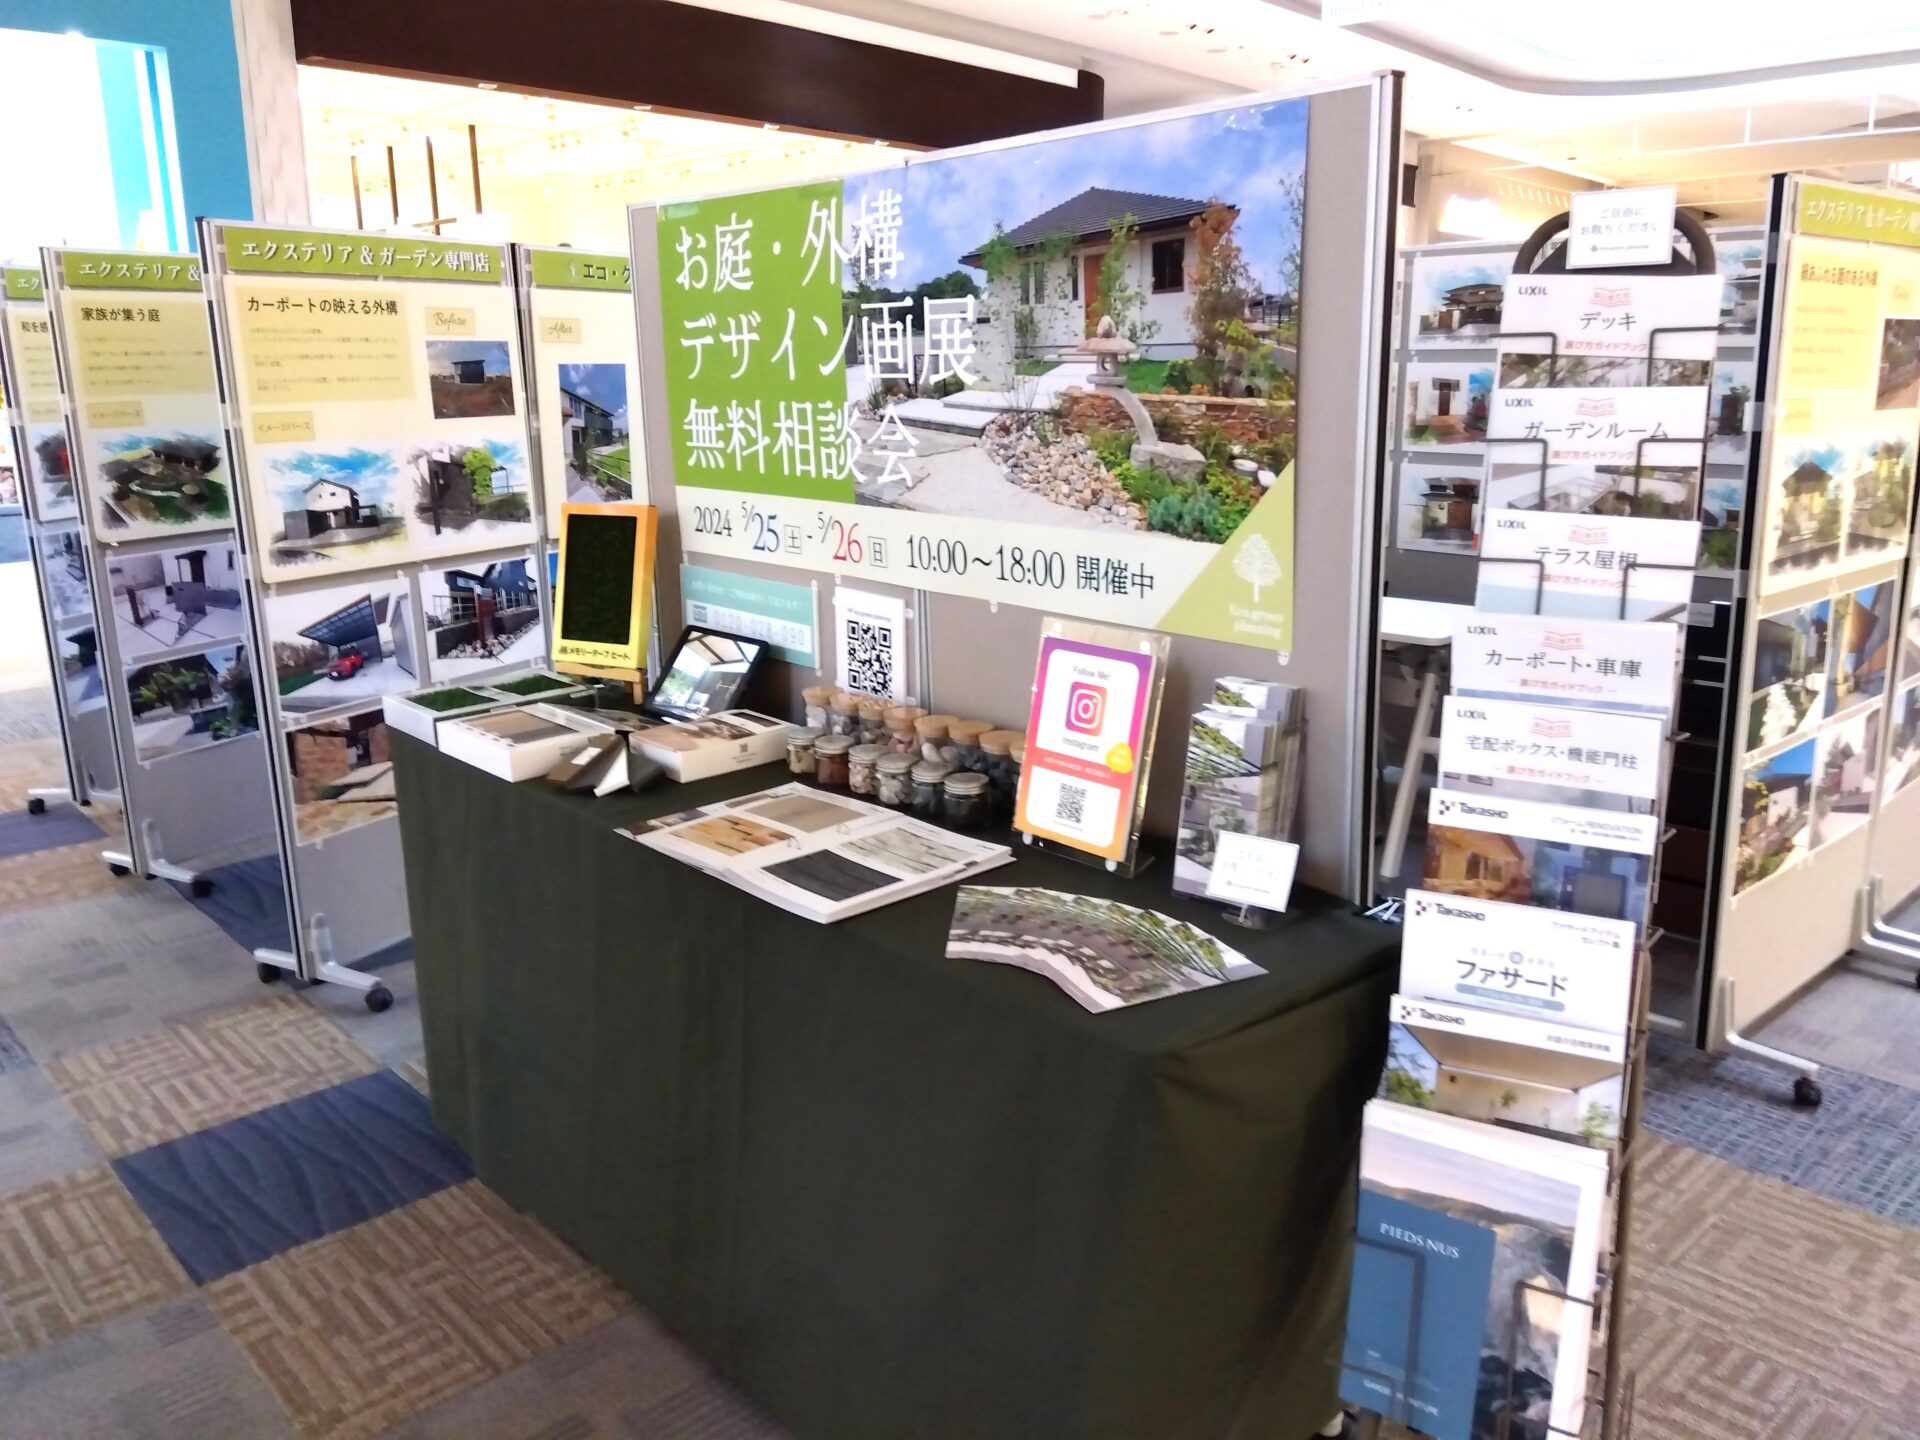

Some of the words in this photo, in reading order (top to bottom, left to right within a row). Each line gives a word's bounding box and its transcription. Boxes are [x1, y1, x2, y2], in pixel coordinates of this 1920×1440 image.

[675, 188, 905, 293] お庭・外構
[242, 240, 352, 264] エクステリア
[360, 245, 374, 266] &
[380, 247, 490, 273] ガーデン専門店
[79, 262, 182, 281] エクステリア
[188, 265, 200, 282] &
[17, 277, 40, 290] エク
[1518, 285, 1548, 296] LIXIL
[81, 307, 160, 322] 家族が集う庭
[247, 296, 398, 316] カーポートの映える外構
[433, 312, 468, 331] Before
[1580, 311, 1637, 331] デッキ
[680, 294, 978, 386] デザイン画展
[1505, 398, 1534, 407] LIXIL
[1523, 420, 1668, 439] ガーデンルーム
[683, 398, 920, 488] 無料相談会
[1497, 519, 1527, 529] LIXIL
[694, 506, 733, 537] 2024
[1076, 555, 1154, 599] 開催中
[1534, 546, 1639, 572] テラス屋根
[1467, 625, 1498, 636] LIXIL
[1485, 648, 1643, 679] カーポート・車庫
[1457, 708, 1488, 721] LIXIL
[1466, 735, 1639, 771] 宅配ボックス・機能門柱
[1456, 959, 1569, 997] ファサード
[1380, 1222, 1424, 1248] PIEDS
[1425, 1237, 1460, 1259] NUS
